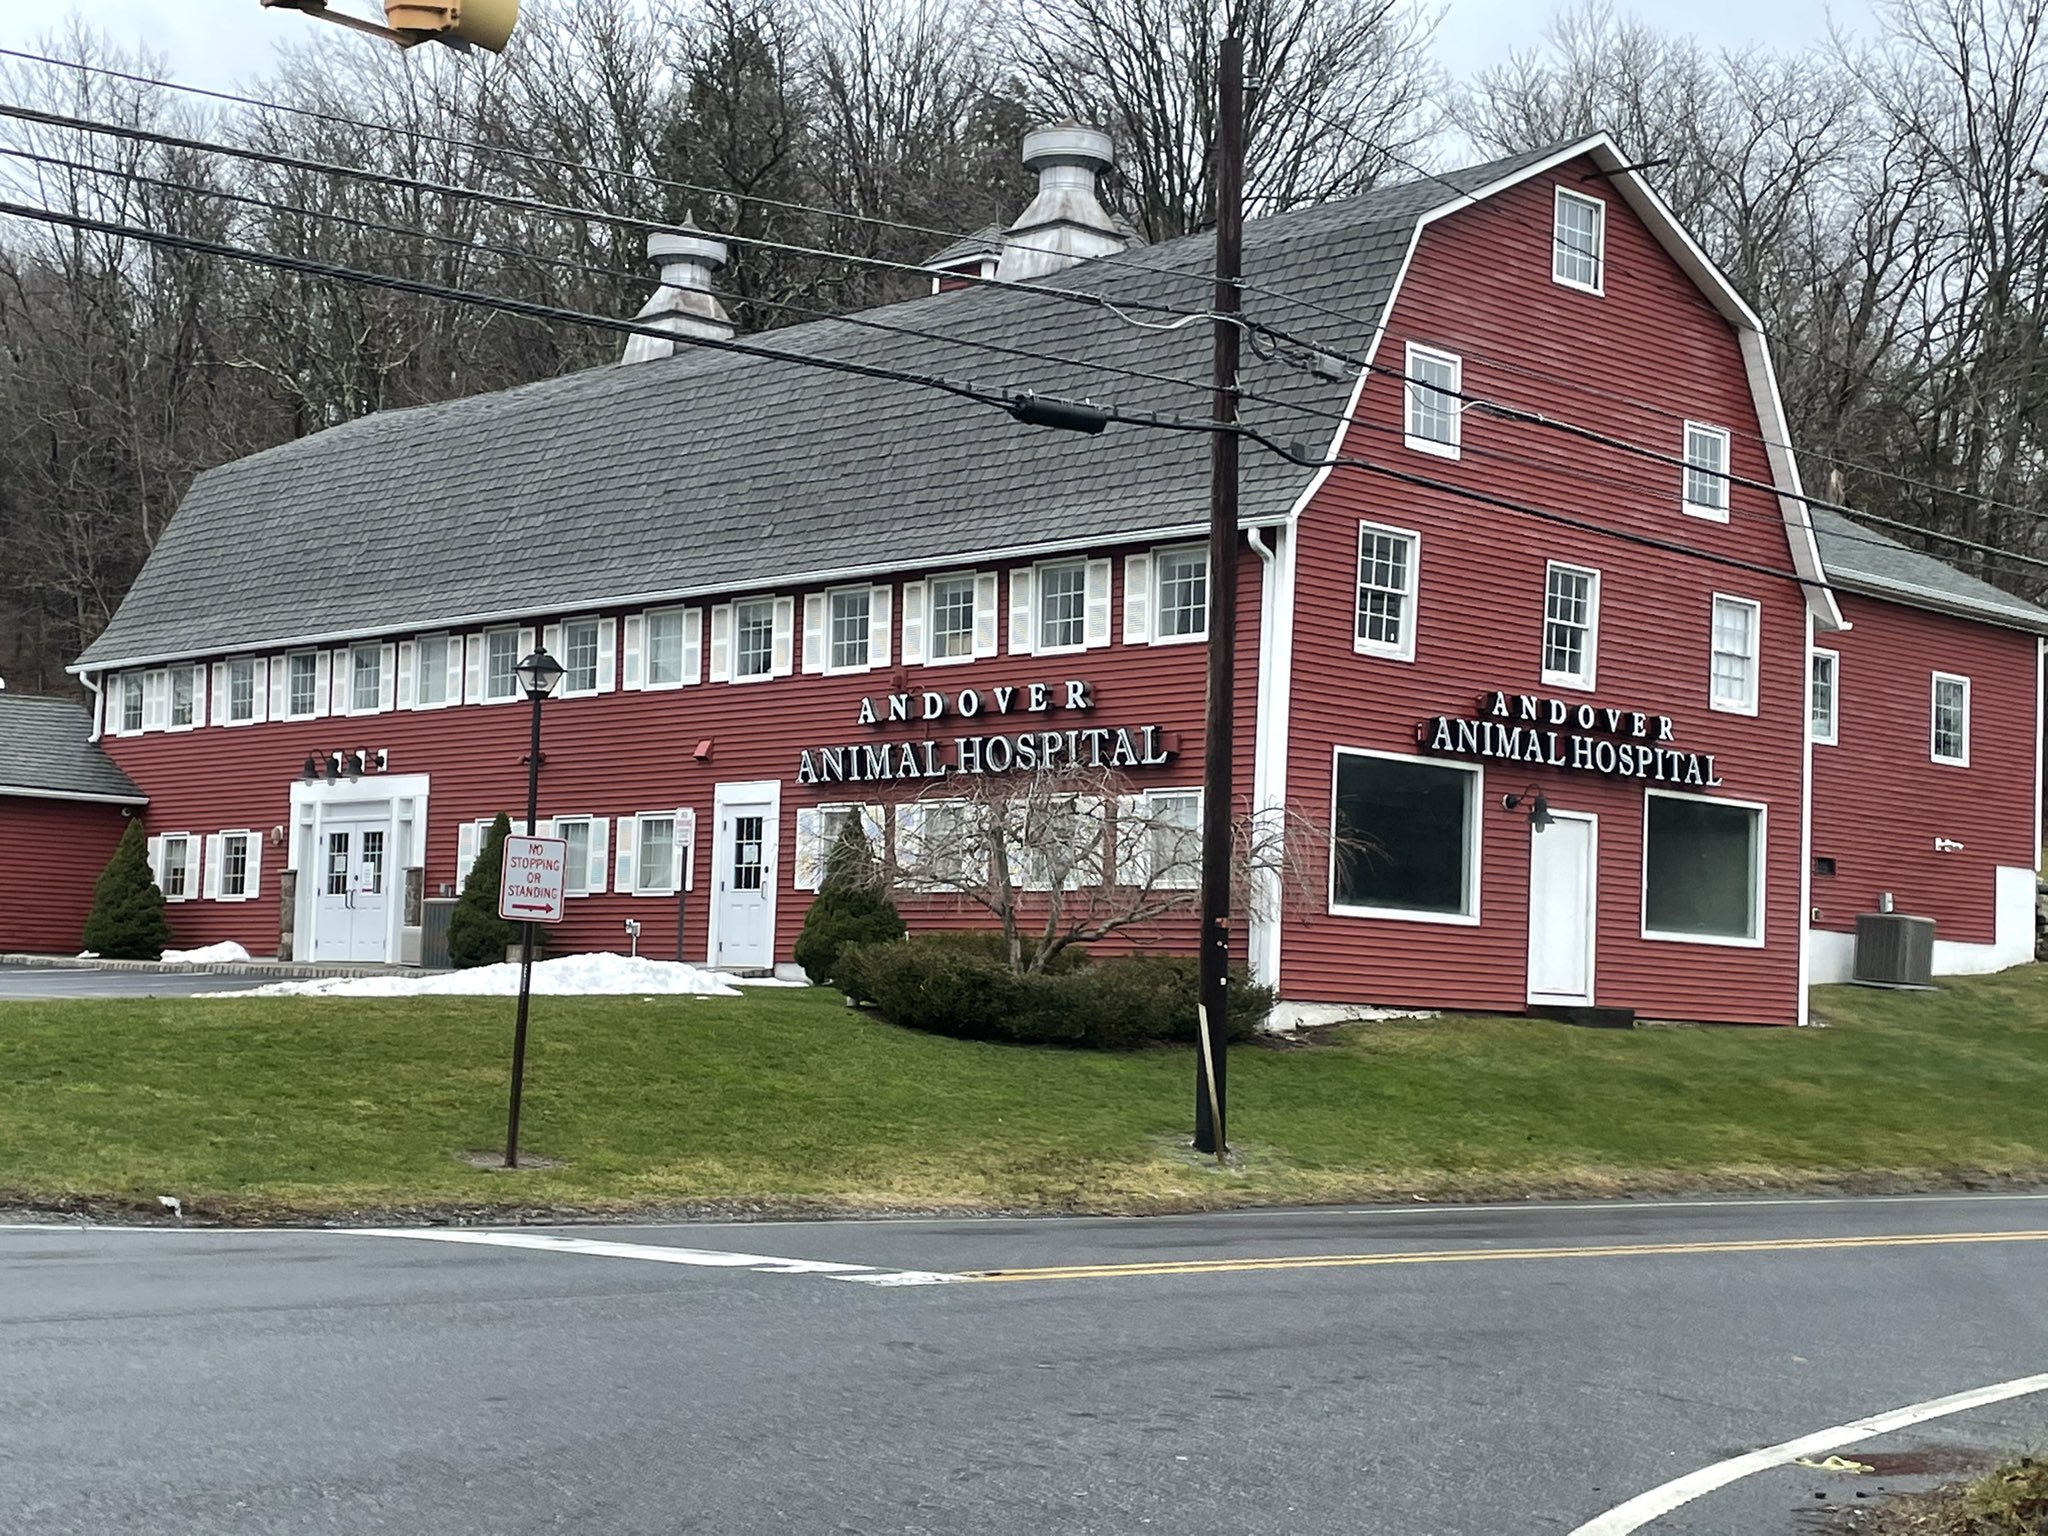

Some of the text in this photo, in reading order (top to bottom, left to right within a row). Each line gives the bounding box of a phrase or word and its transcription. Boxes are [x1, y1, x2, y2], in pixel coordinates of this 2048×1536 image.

[857, 680, 1091, 724] ANDOVER
[1492, 691, 1674, 741] ANDOVER
[796, 725, 1168, 784] ANIMAL HOSPITAL
[1432, 716, 1723, 786] ANIMAL HOSPITAL
[510, 856, 560, 871] STOPPING
[528, 844, 544, 856] NO
[508, 885, 558, 899] STANDING
[526, 872, 541, 884] OR
